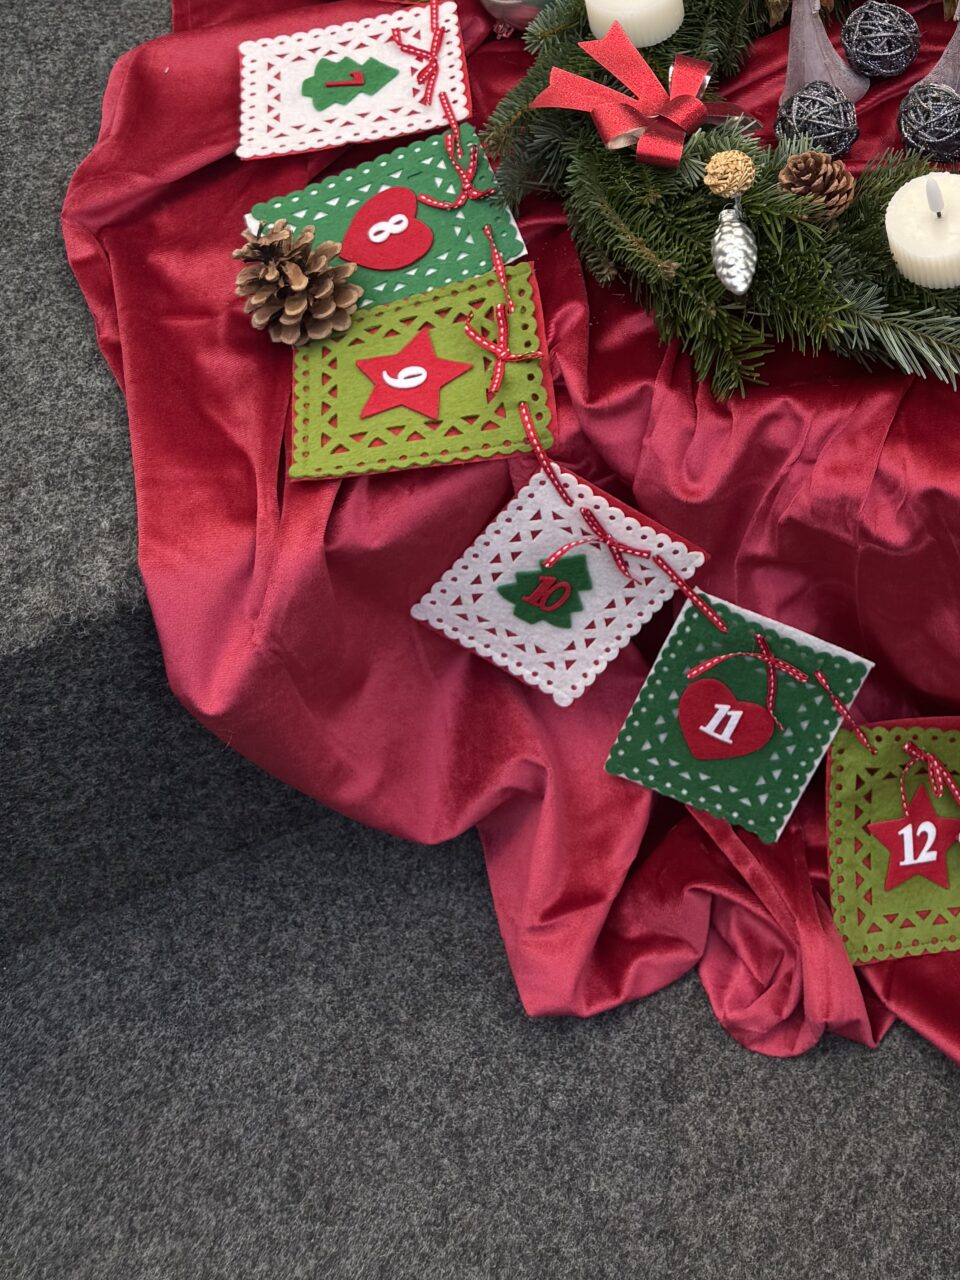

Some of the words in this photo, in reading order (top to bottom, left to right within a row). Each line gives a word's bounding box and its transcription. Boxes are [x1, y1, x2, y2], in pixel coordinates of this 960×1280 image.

[324, 70, 365, 88] 7
[367, 213, 409, 244] 8
[382, 365, 428, 389] 9
[520, 574, 572, 613] 10
[699, 703, 744, 744] 11
[897, 820, 938, 867] 12
